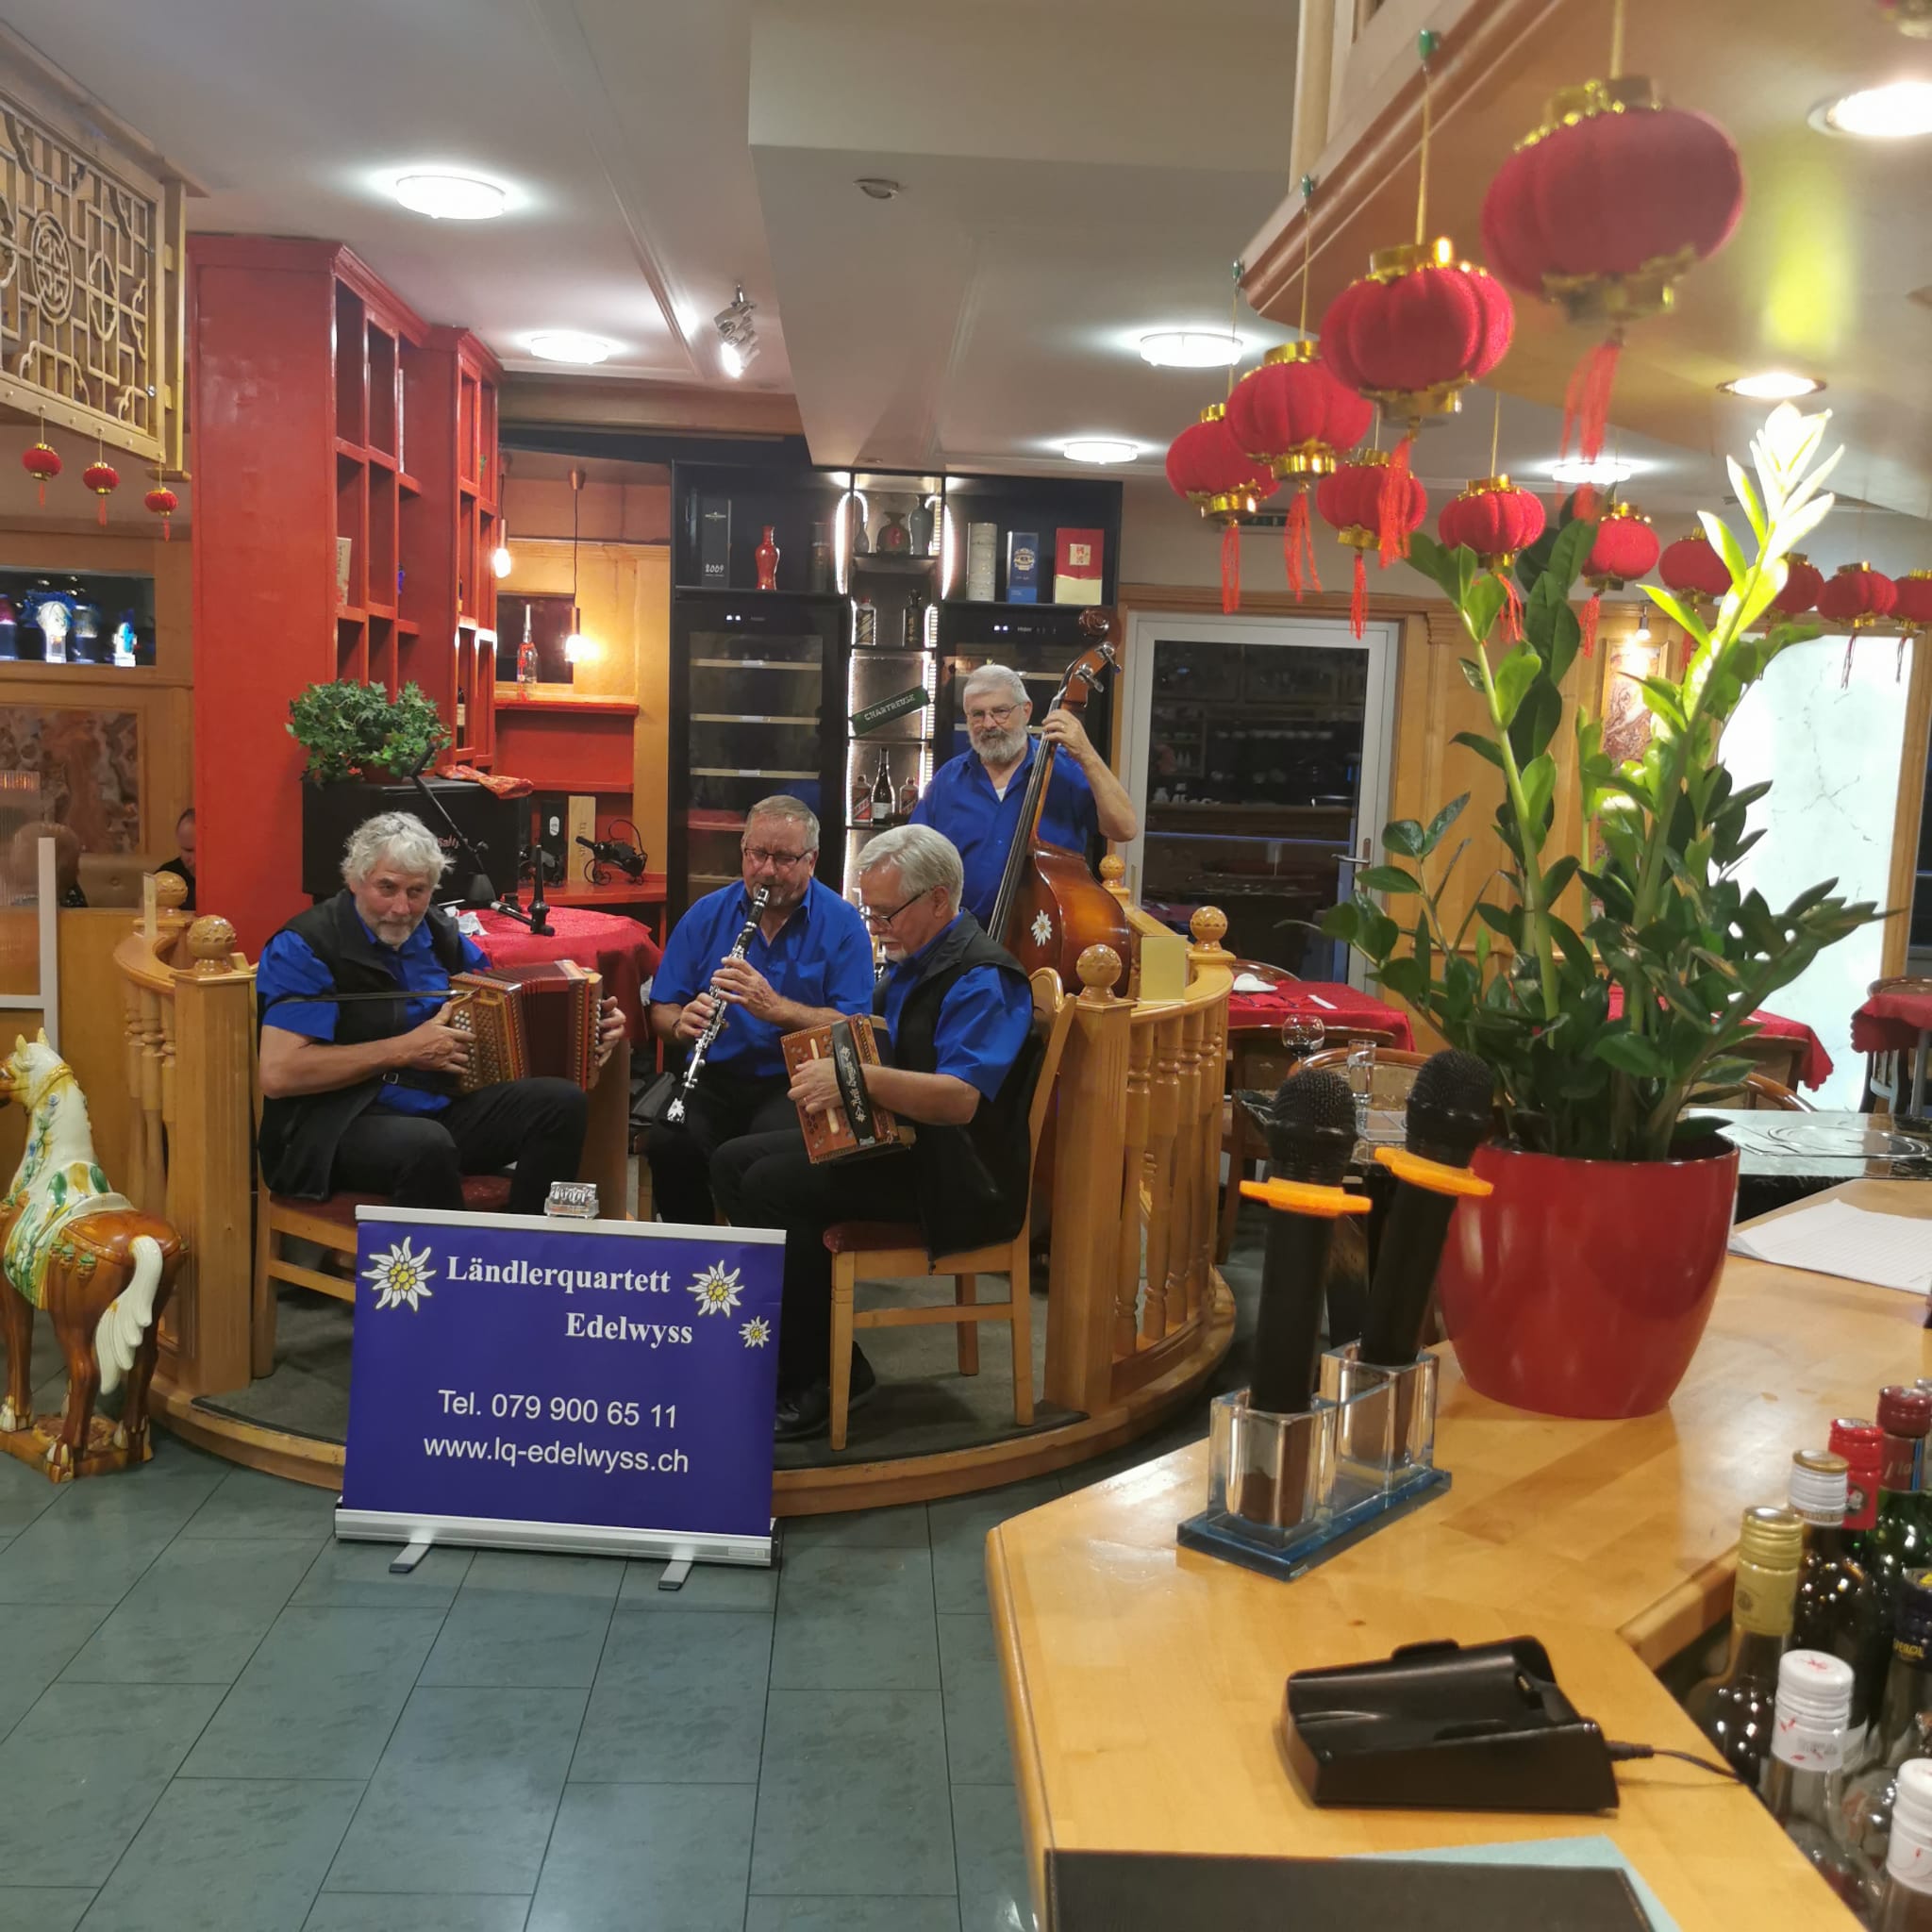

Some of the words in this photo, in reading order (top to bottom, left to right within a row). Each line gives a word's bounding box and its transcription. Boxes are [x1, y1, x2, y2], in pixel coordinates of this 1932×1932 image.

[863, 693, 916, 721] CHARTREUSE
[446, 1256, 671, 1294] Ländlerquartett
[565, 1312, 693, 1349] Edelwyss
[438, 1390, 482, 1415] Tel.
[491, 1393, 541, 1419] 079
[550, 1397, 598, 1423] 900
[607, 1401, 640, 1426] 65
[650, 1404, 676, 1428] 11
[424, 1437, 689, 1474] www.lq-edelwyss.ch
